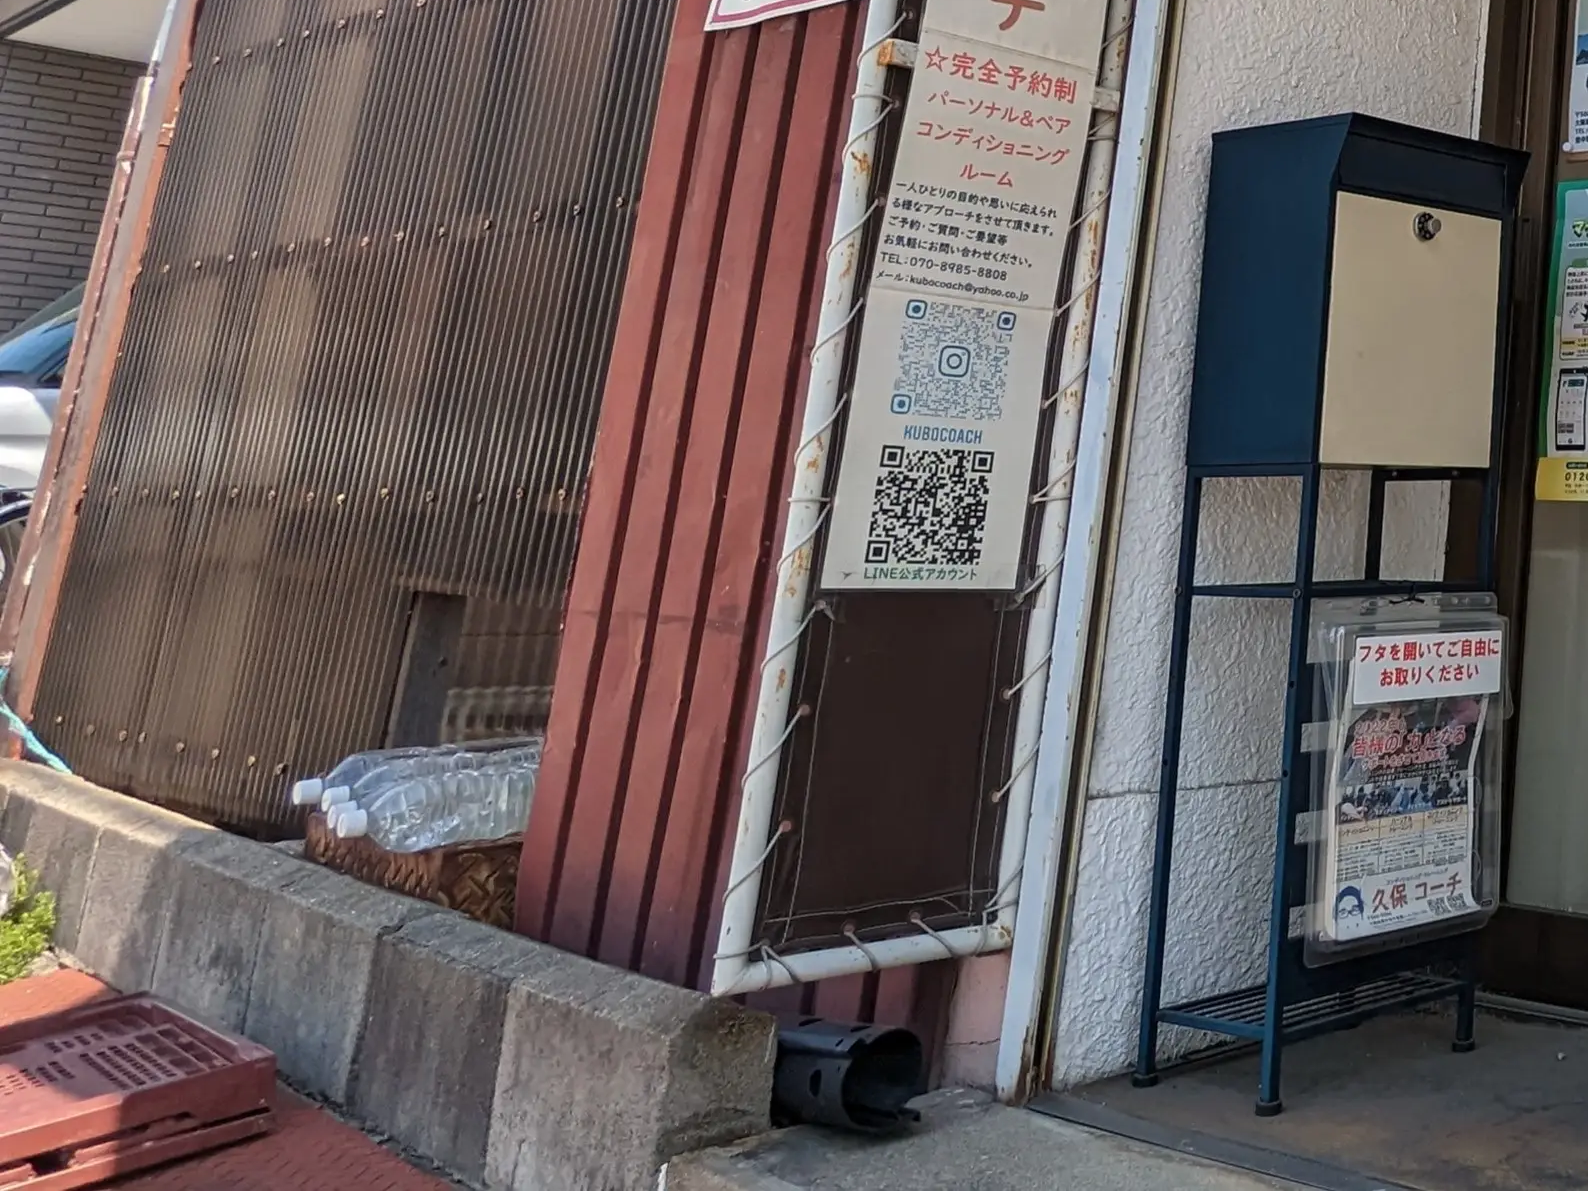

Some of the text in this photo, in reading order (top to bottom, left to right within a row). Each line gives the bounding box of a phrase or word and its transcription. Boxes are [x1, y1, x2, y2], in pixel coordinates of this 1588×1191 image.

[916, 121, 1070, 167] コンディショニング
[960, 164, 1014, 189] ルーム
[904, 423, 983, 445] KUBOCOACH
[863, 566, 978, 582] LINE公式アカウント
[1359, 638, 1500, 663] フタを開いてご自由に
[1379, 664, 1480, 688] お取りください
[1371, 871, 1463, 914] 久保 コーチ
